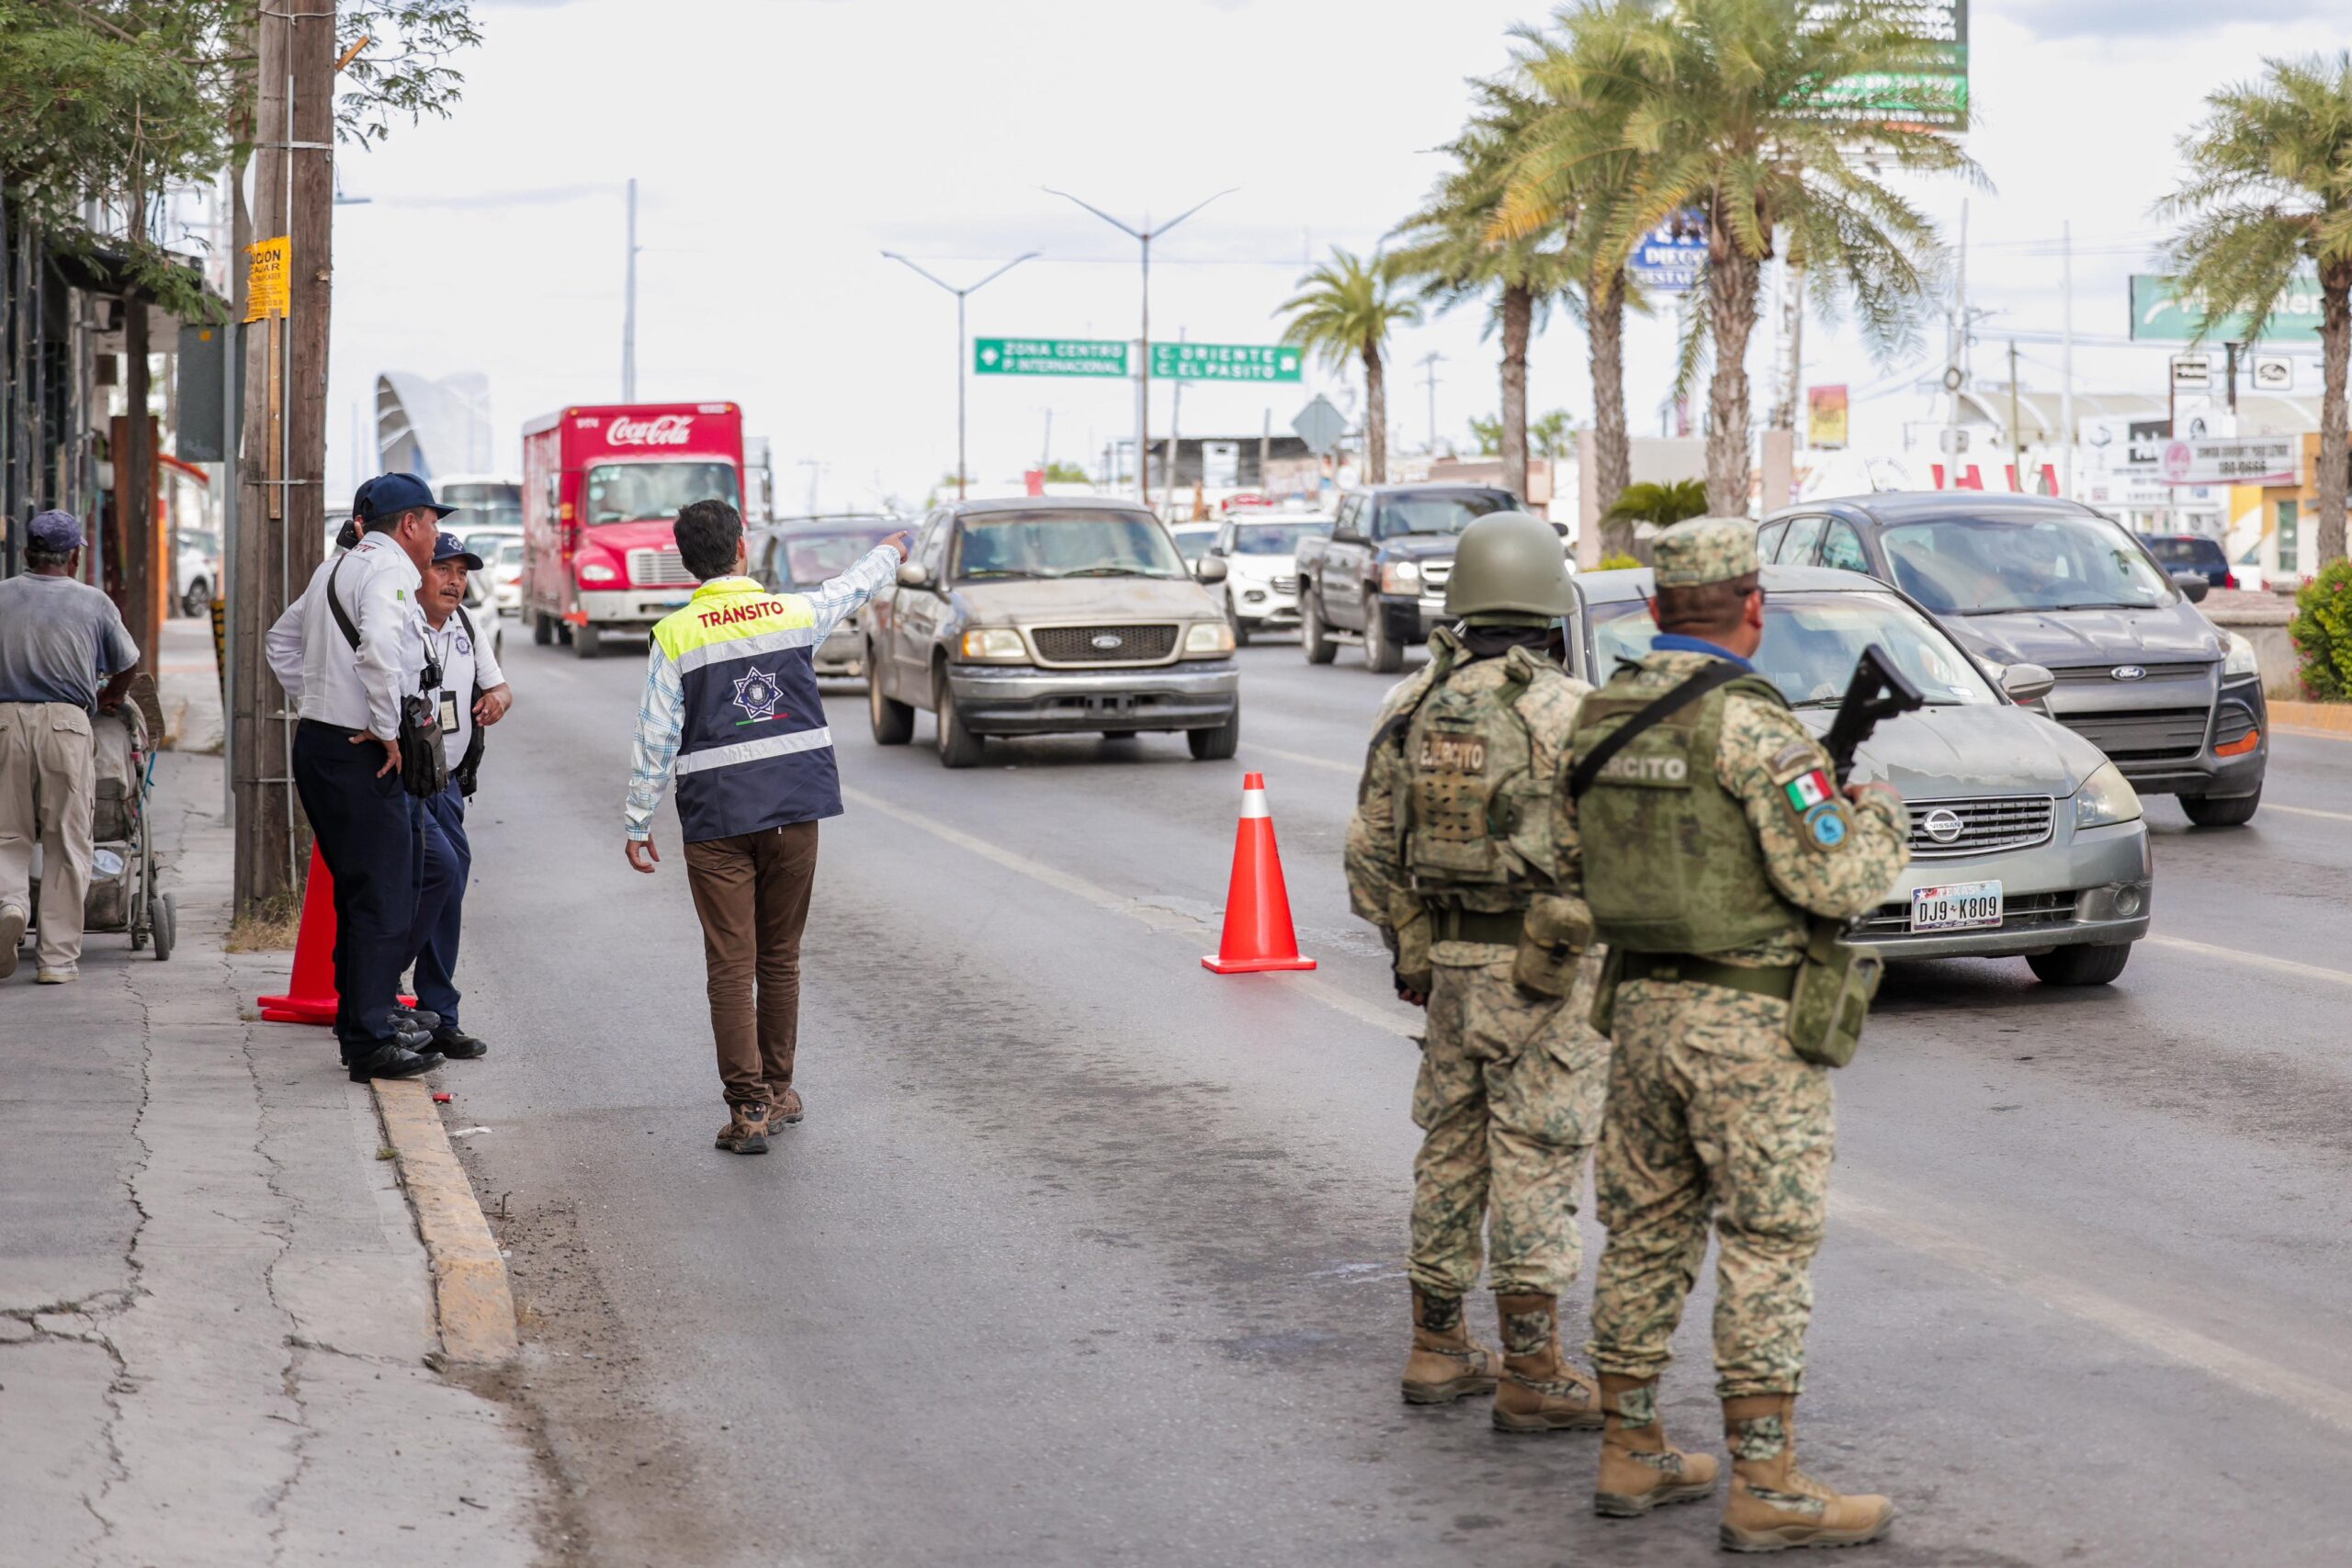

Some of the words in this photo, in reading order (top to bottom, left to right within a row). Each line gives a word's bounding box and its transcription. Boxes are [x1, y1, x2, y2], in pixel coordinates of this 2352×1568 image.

[1003, 342, 1051, 355] ZONA
[1056, 344, 1124, 357] CENTRO
[1180, 347, 1275, 363] ORIENTE
[1178, 362, 1202, 377] EL
[1205, 364, 1276, 378] PASITO
[606, 415, 695, 446] Coca-Cola
[697, 602, 784, 628] TRÁNSITO
[1939, 886, 1975, 897] TEXAS
[1920, 901, 1948, 922] DJ9
[1959, 897, 1996, 919] K809
